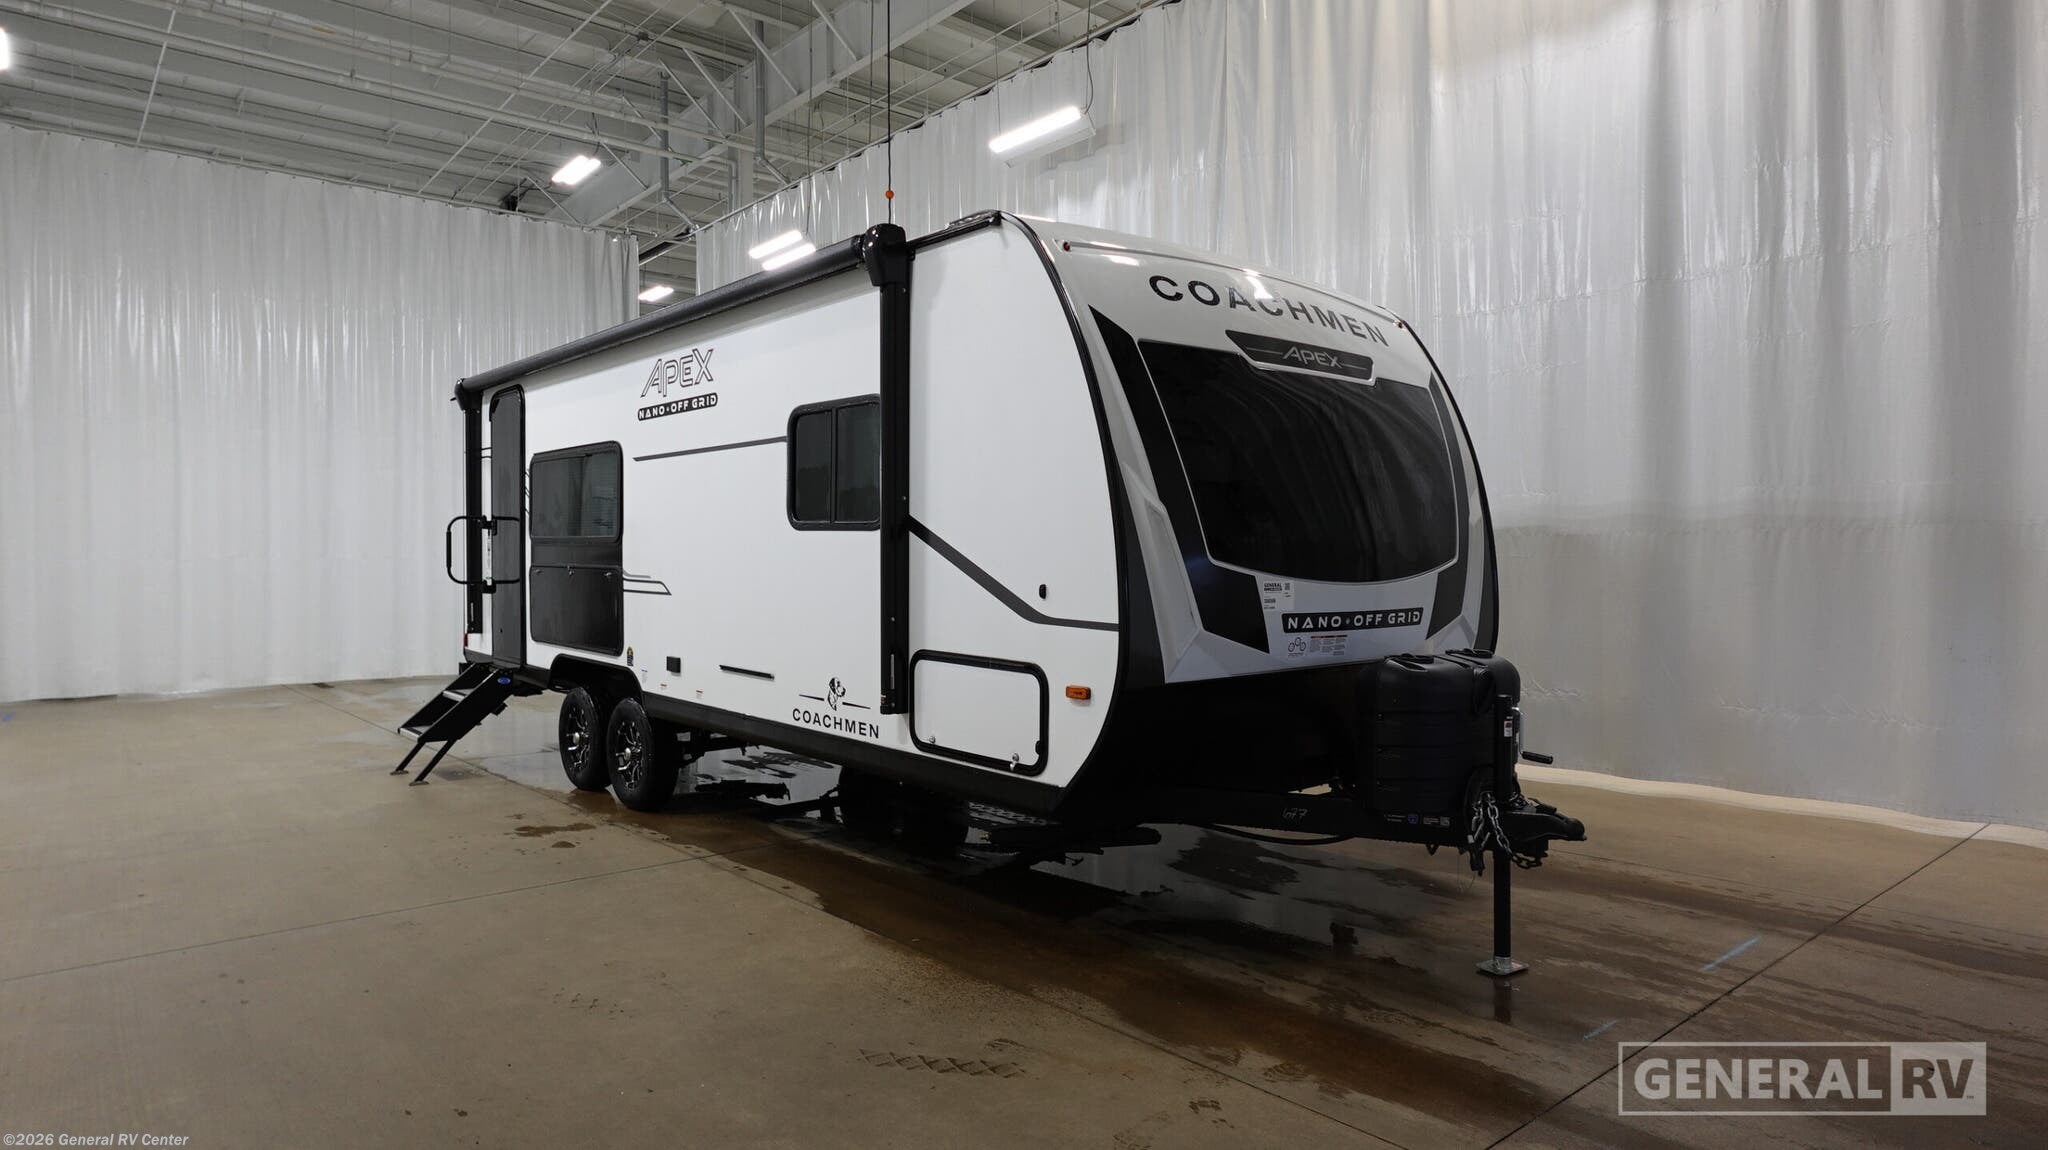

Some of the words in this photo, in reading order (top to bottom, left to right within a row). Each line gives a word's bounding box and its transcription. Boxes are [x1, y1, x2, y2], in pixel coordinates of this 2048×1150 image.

[1149, 275, 1389, 347] COACHMEN
[1283, 346, 1343, 369] APEX
[640, 348, 714, 398] APEX
[639, 407, 665, 419] NANO
[670, 400, 688, 412] OFF
[691, 394, 717, 408] GRID
[1287, 616, 1342, 630] NANO
[1353, 613, 1384, 627] OFF
[1387, 610, 1421, 624] GRID
[792, 708, 879, 739] COACHMEN
